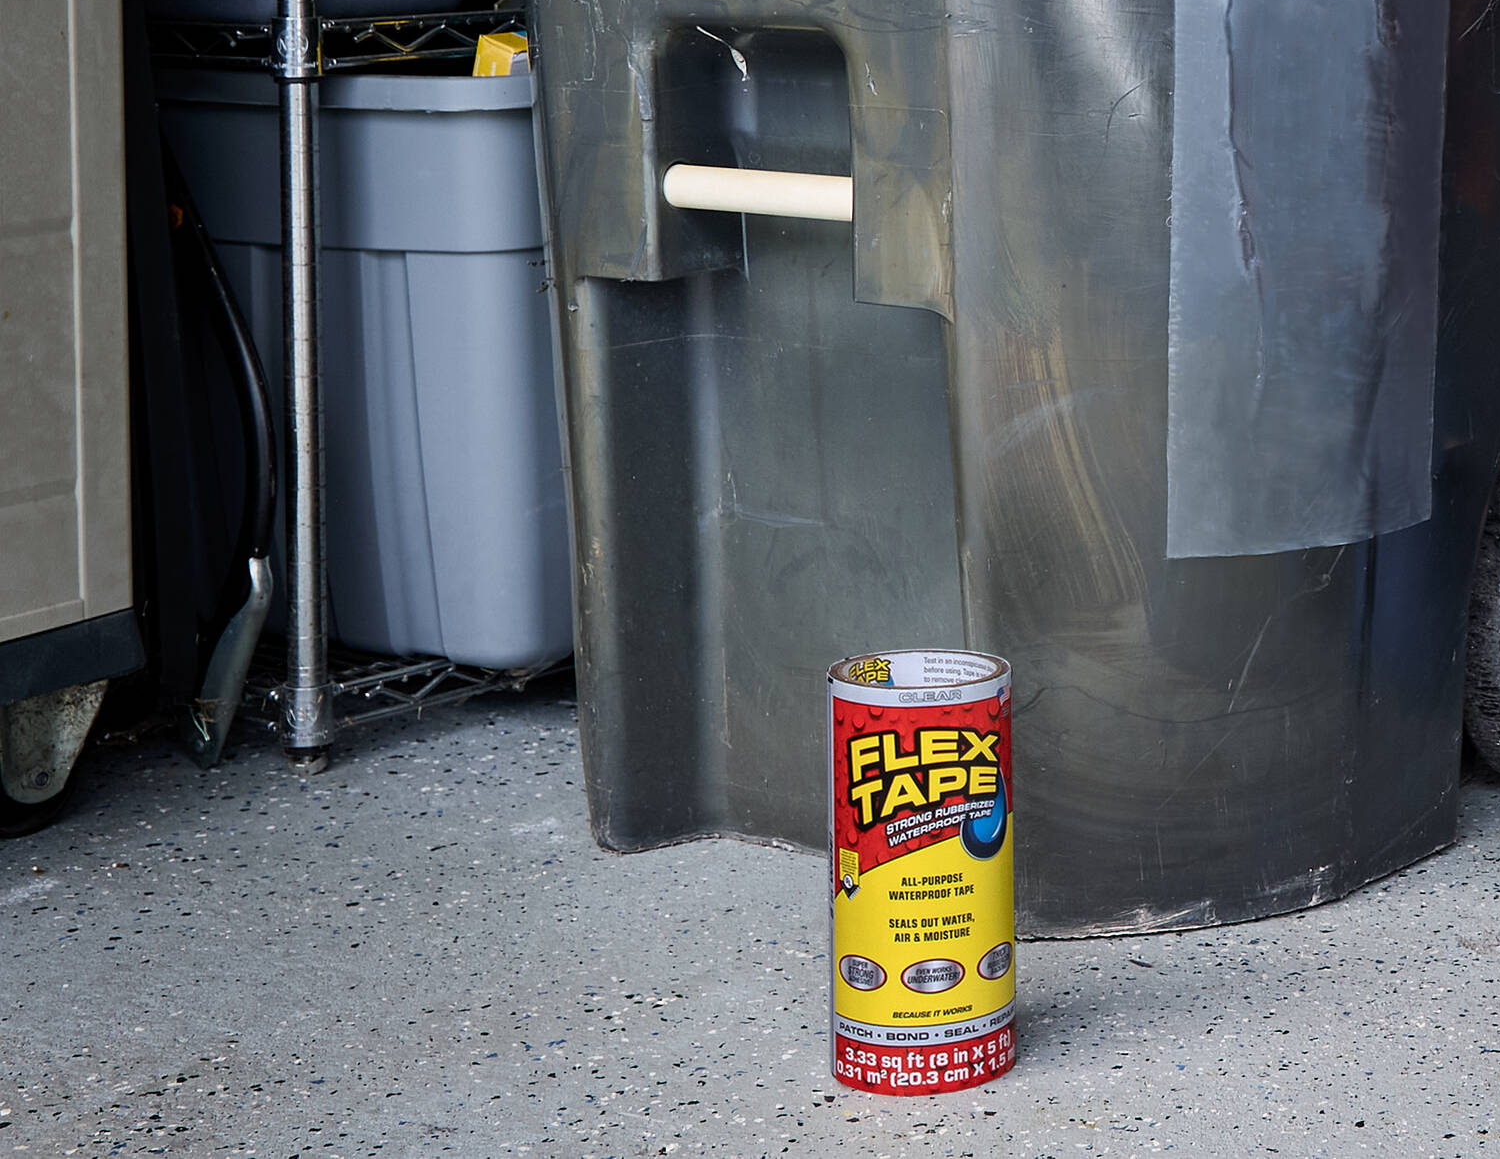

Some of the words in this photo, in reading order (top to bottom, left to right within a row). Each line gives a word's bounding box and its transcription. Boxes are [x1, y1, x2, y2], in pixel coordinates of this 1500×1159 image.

[849, 659, 890, 677] FLEX
[856, 670, 889, 683] APE
[899, 690, 962, 704] CLEAR
[850, 730, 998, 783] FLEX
[851, 766, 998, 825] TAPE
[886, 811, 933, 835] STRONG
[934, 800, 995, 819] RUBBERIZED
[888, 814, 967, 847] WATERPROOF
[969, 809, 992, 820] TAPE
[901, 872, 964, 887] ALL-PURPOSE
[888, 888, 952, 901] WATERPROOF
[954, 884, 975, 897] TAPE
[888, 918, 918, 929] SEALS
[920, 917, 939, 928] OUT
[941, 912, 975, 926] WATER,
[894, 932, 911, 943] AIR
[913, 932, 920, 943] &
[923, 926, 971, 942] MOISTURE
[848, 965, 874, 980] STRONG
[892, 1010, 932, 1019] BECAUSE
[933, 1009, 941, 1018] IT
[942, 1004, 973, 1017] WORKS
[839, 1021, 873, 1039] PATCH
[886, 1032, 930, 1041] BOND
[944, 1024, 979, 1038] SEAL
[845, 1046, 877, 1066] 3.33
[881, 1054, 902, 1073] sq
[907, 1052, 924, 1069] ft
[929, 1052, 949, 1069] (8
[953, 1048, 969, 1064] in
[972, 1044, 984, 1060] X
[987, 1040, 996, 1055] 5
[836, 1059, 863, 1081] 0.31
[866, 1070, 887, 1085] m²
[890, 1070, 939, 1087] (20.3
[944, 1066, 969, 1082] cm
[973, 1061, 984, 1077] X
[988, 1051, 1006, 1071] 1.5
